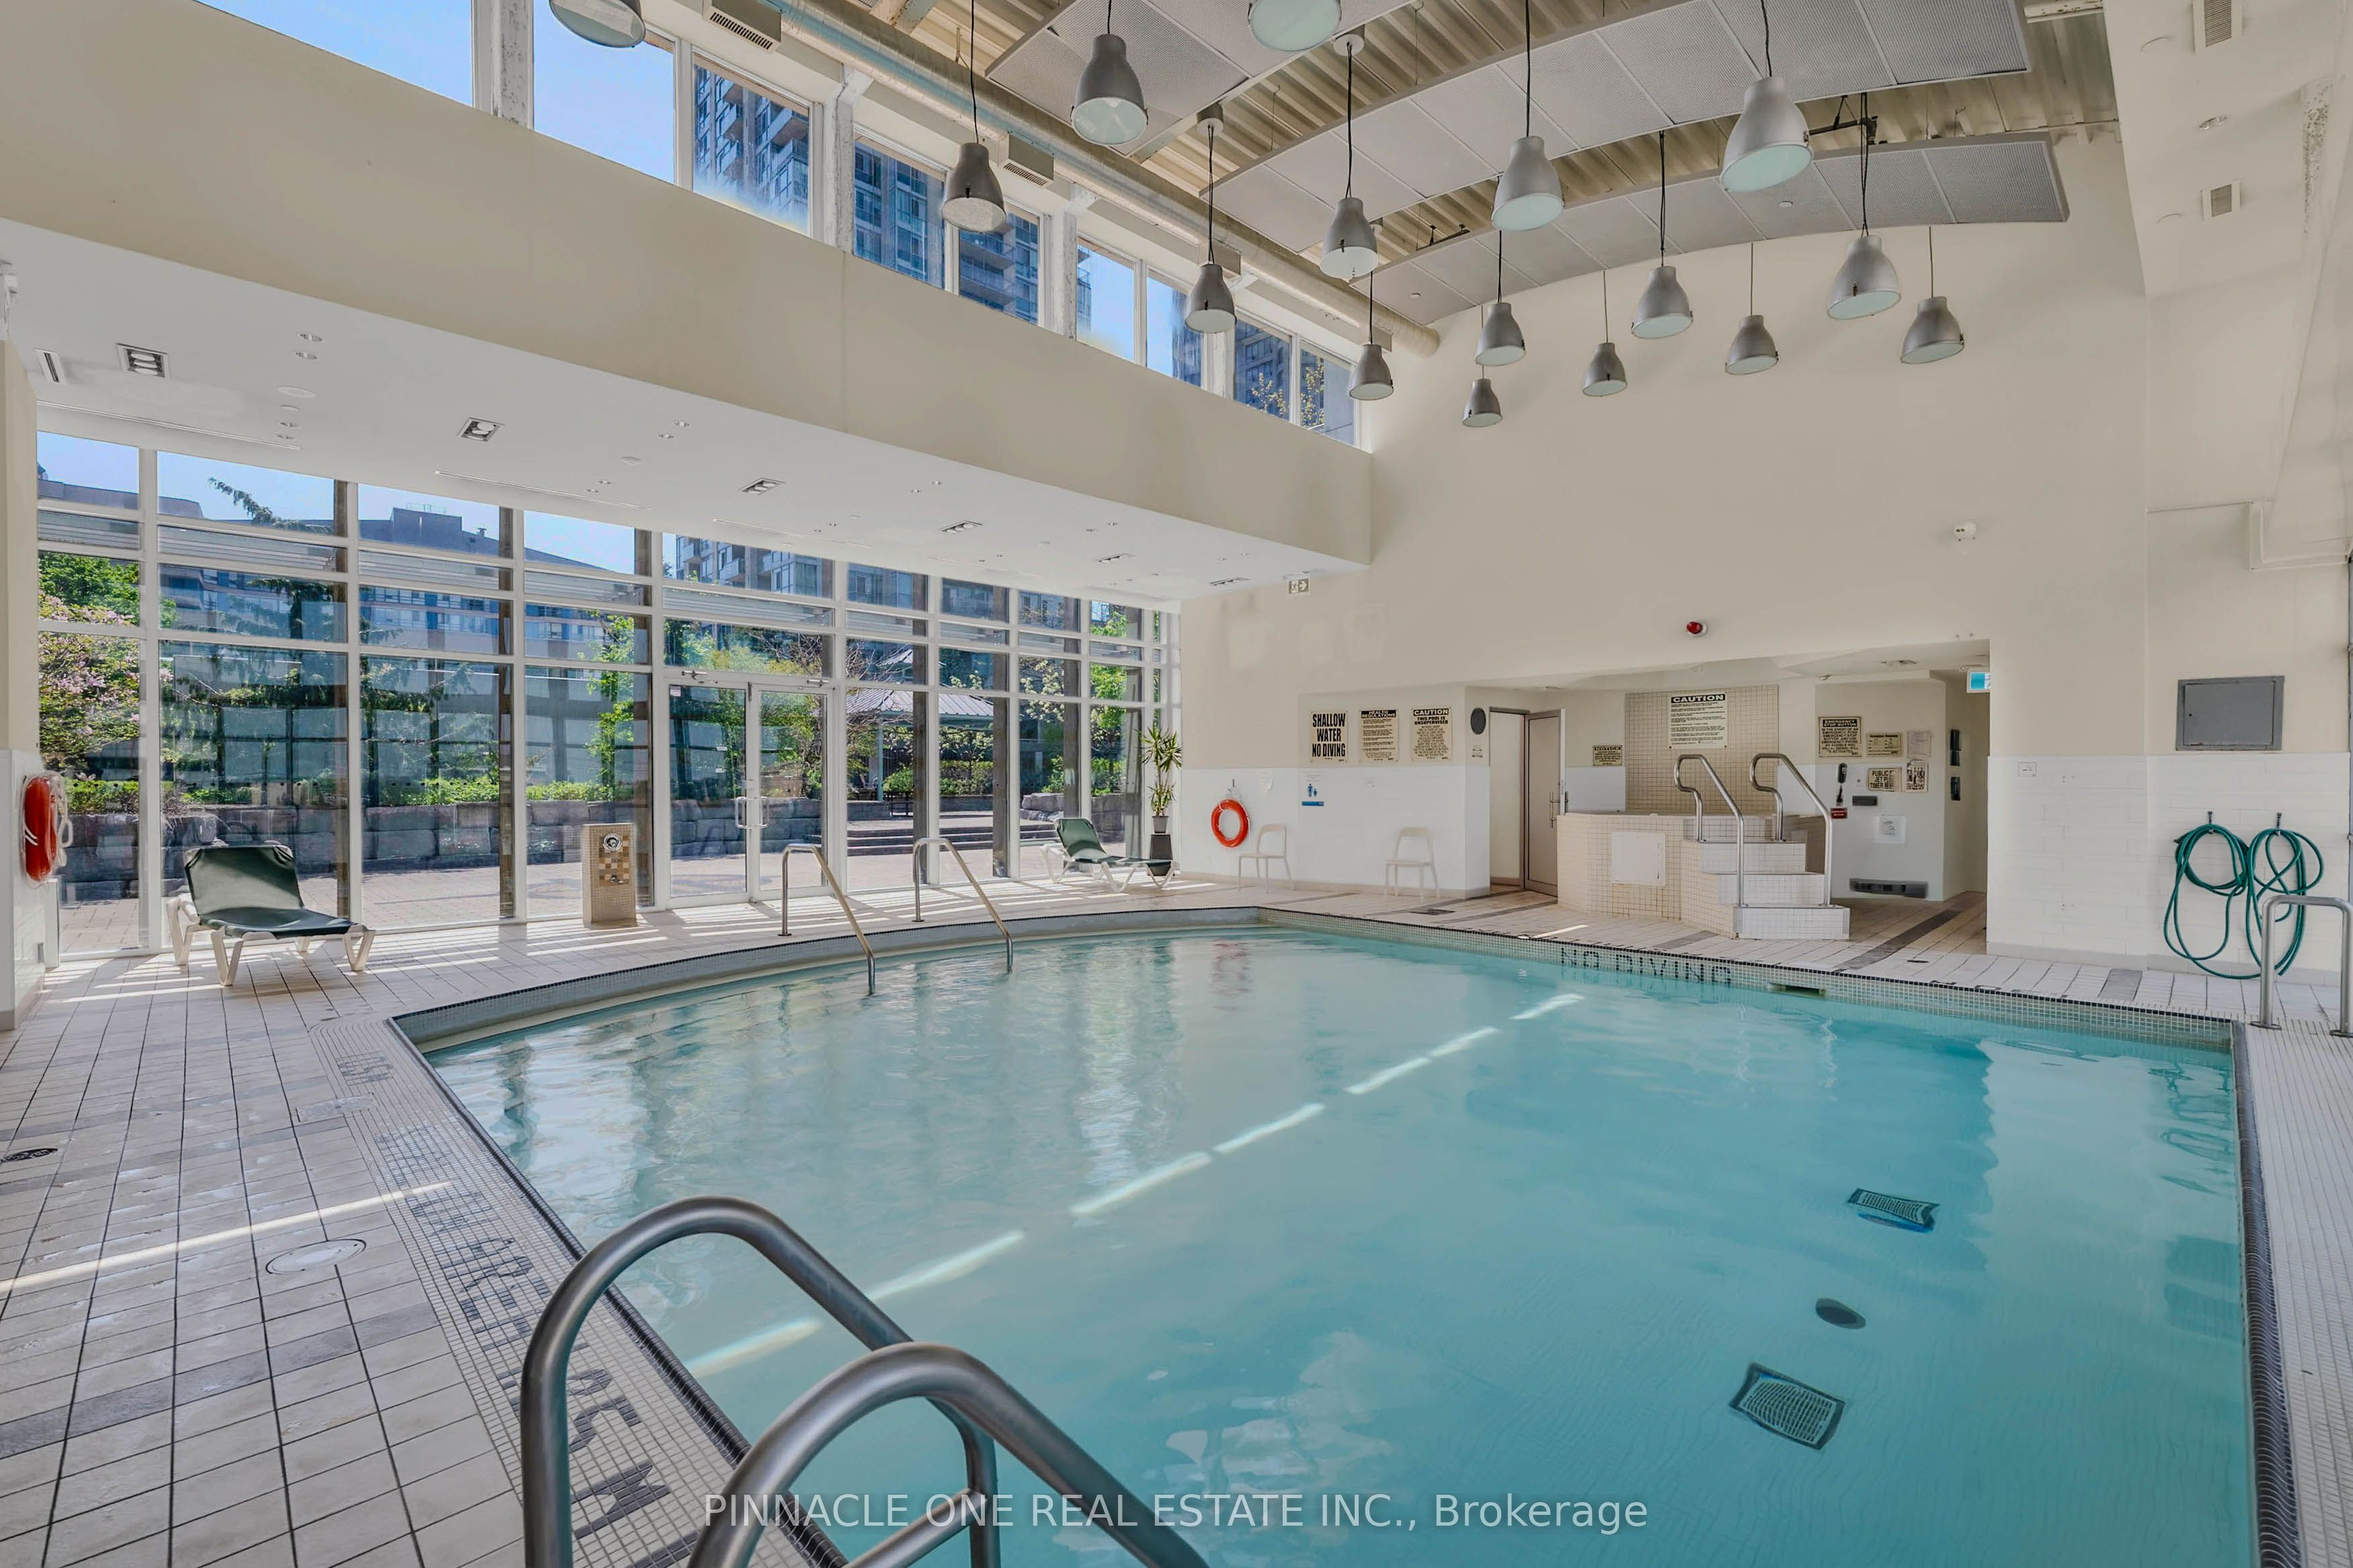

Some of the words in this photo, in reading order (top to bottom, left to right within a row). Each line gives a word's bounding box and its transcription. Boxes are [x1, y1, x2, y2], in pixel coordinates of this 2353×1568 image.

[1673, 695, 1724, 703] CAUTION
[1312, 713, 1346, 727] SHALLOW
[1317, 728, 1341, 742] WATER
[1312, 743, 1321, 757] NO
[1322, 743, 1346, 757] DIVING
[1560, 947, 1599, 968] NO
[1615, 954, 1732, 985] DIVING
